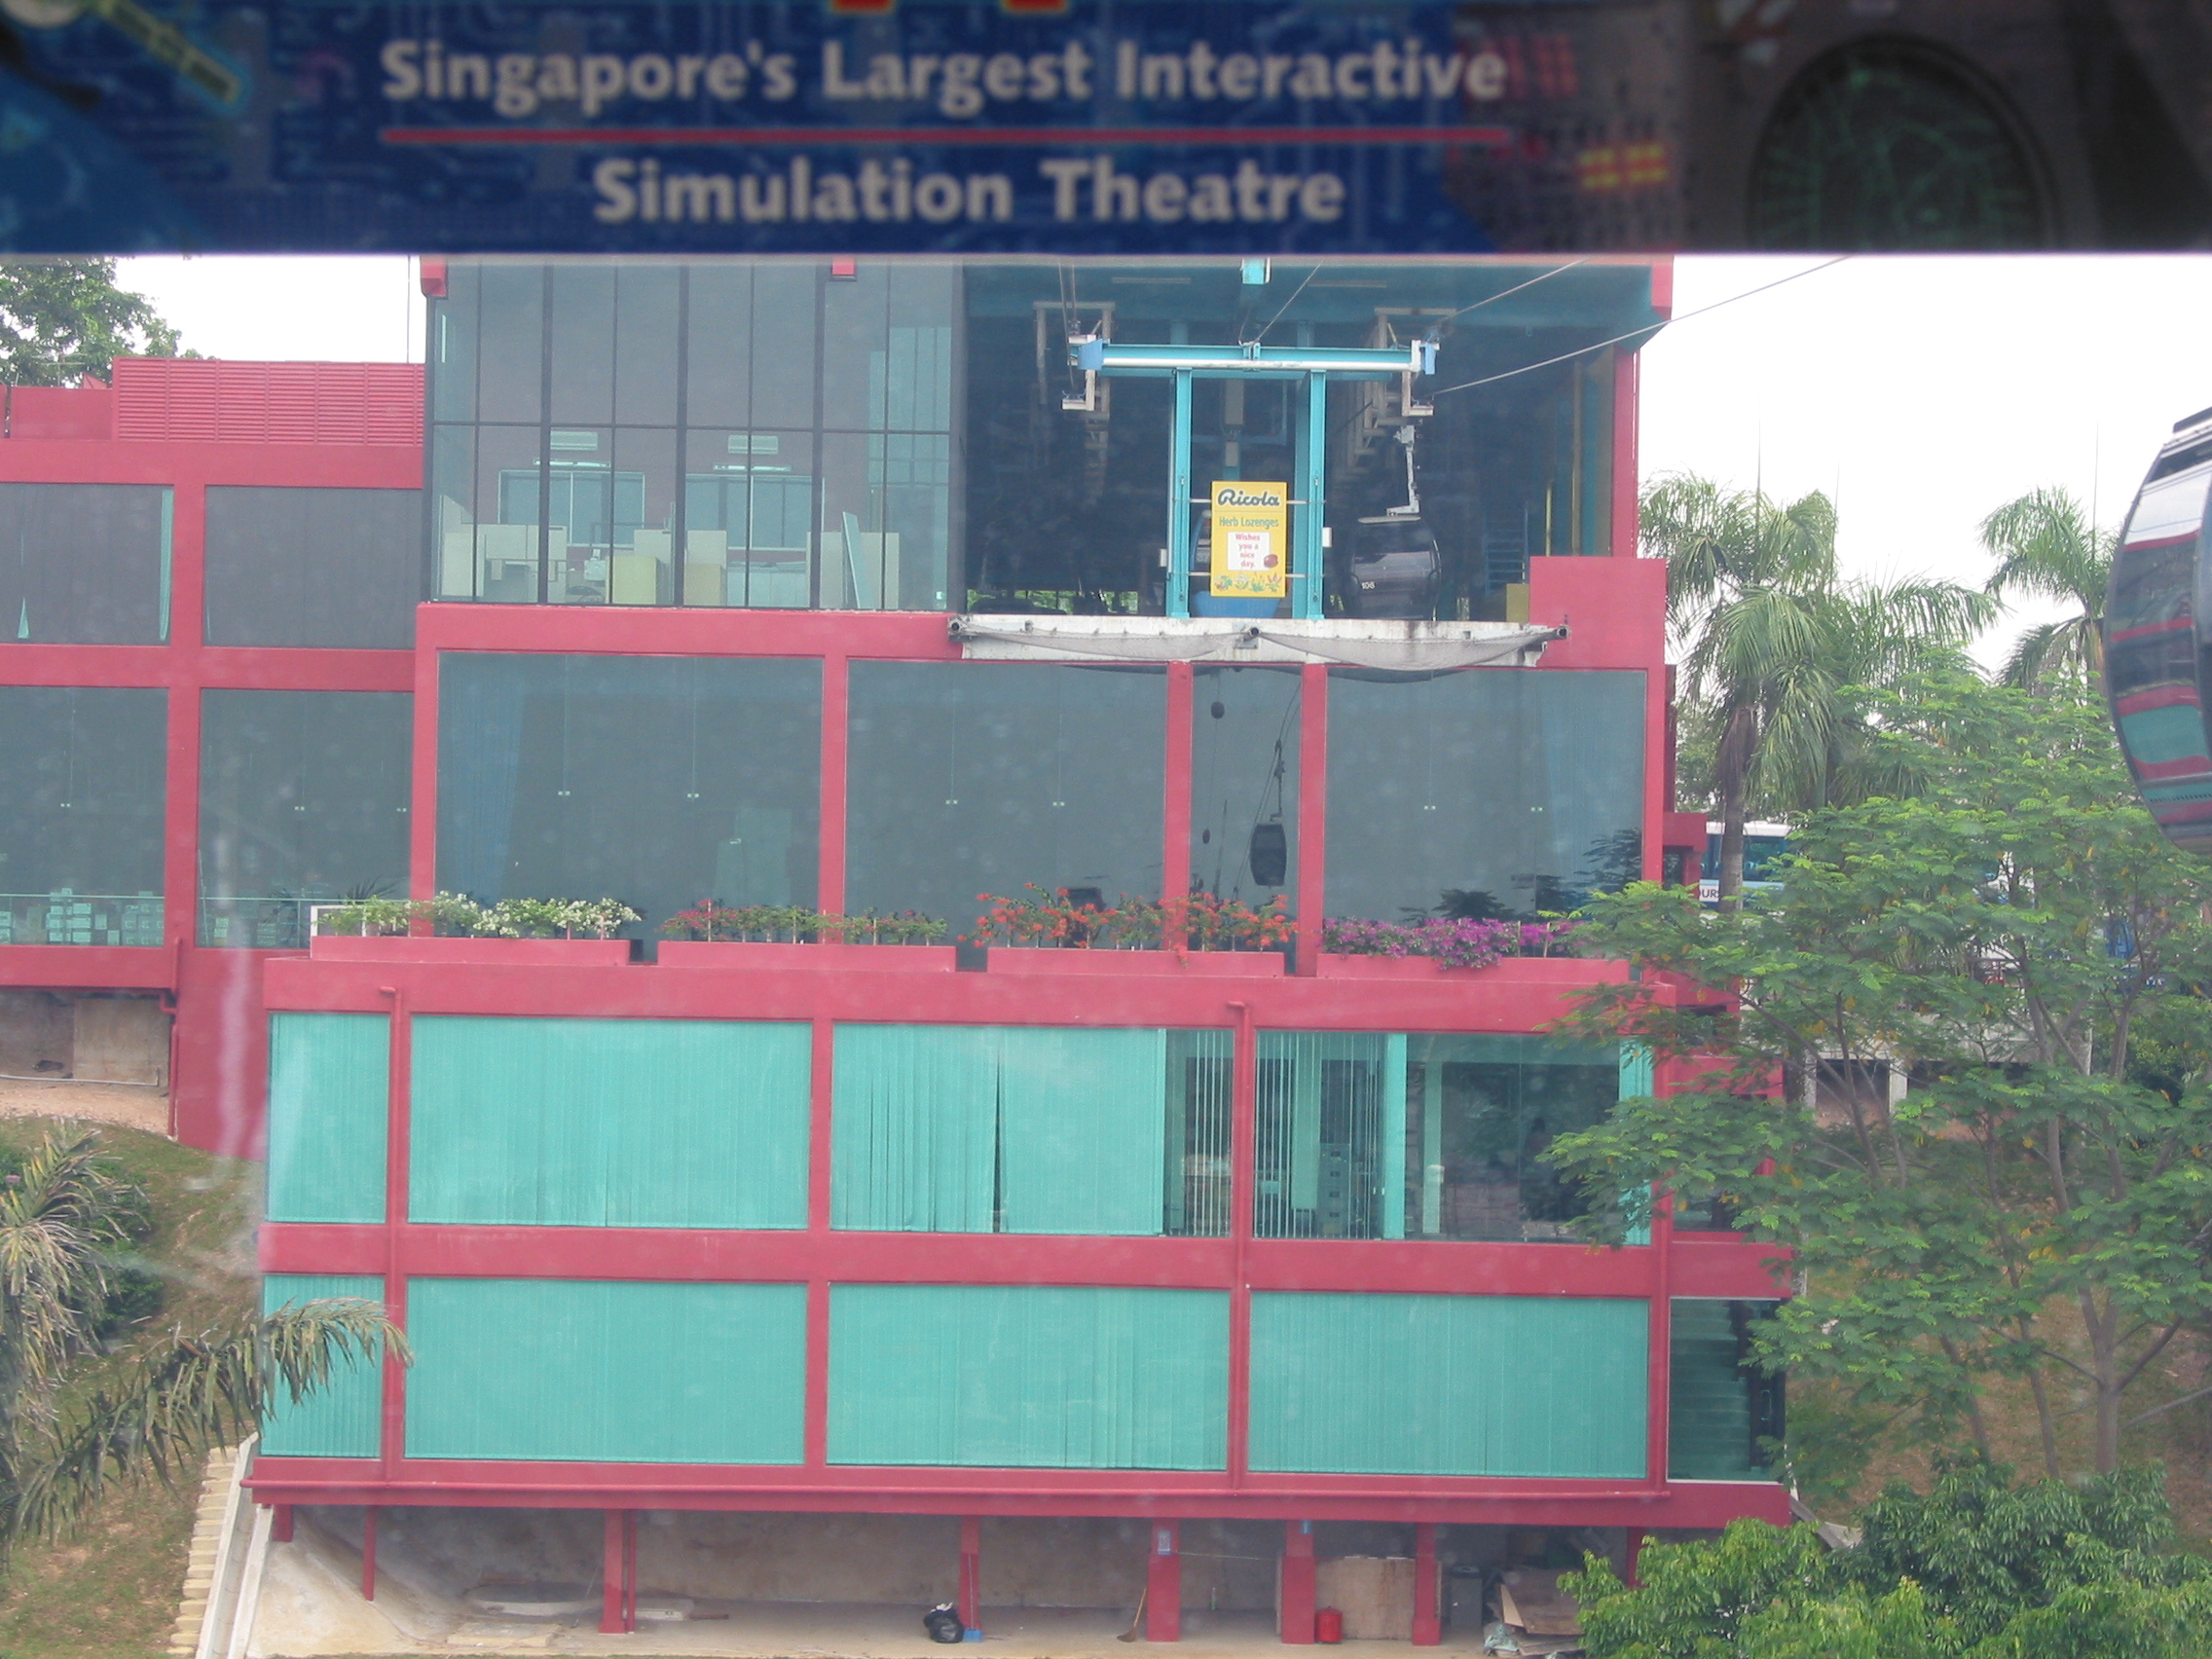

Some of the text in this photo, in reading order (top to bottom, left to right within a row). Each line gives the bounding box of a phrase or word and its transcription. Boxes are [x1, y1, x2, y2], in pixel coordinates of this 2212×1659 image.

[380, 37, 1508, 118] Singapore's Largest Interactive
[593, 155, 1346, 222] Simulation Theatre
[1218, 489, 1280, 505] Ricola
[1219, 517, 1278, 530] Herb Lozenges
